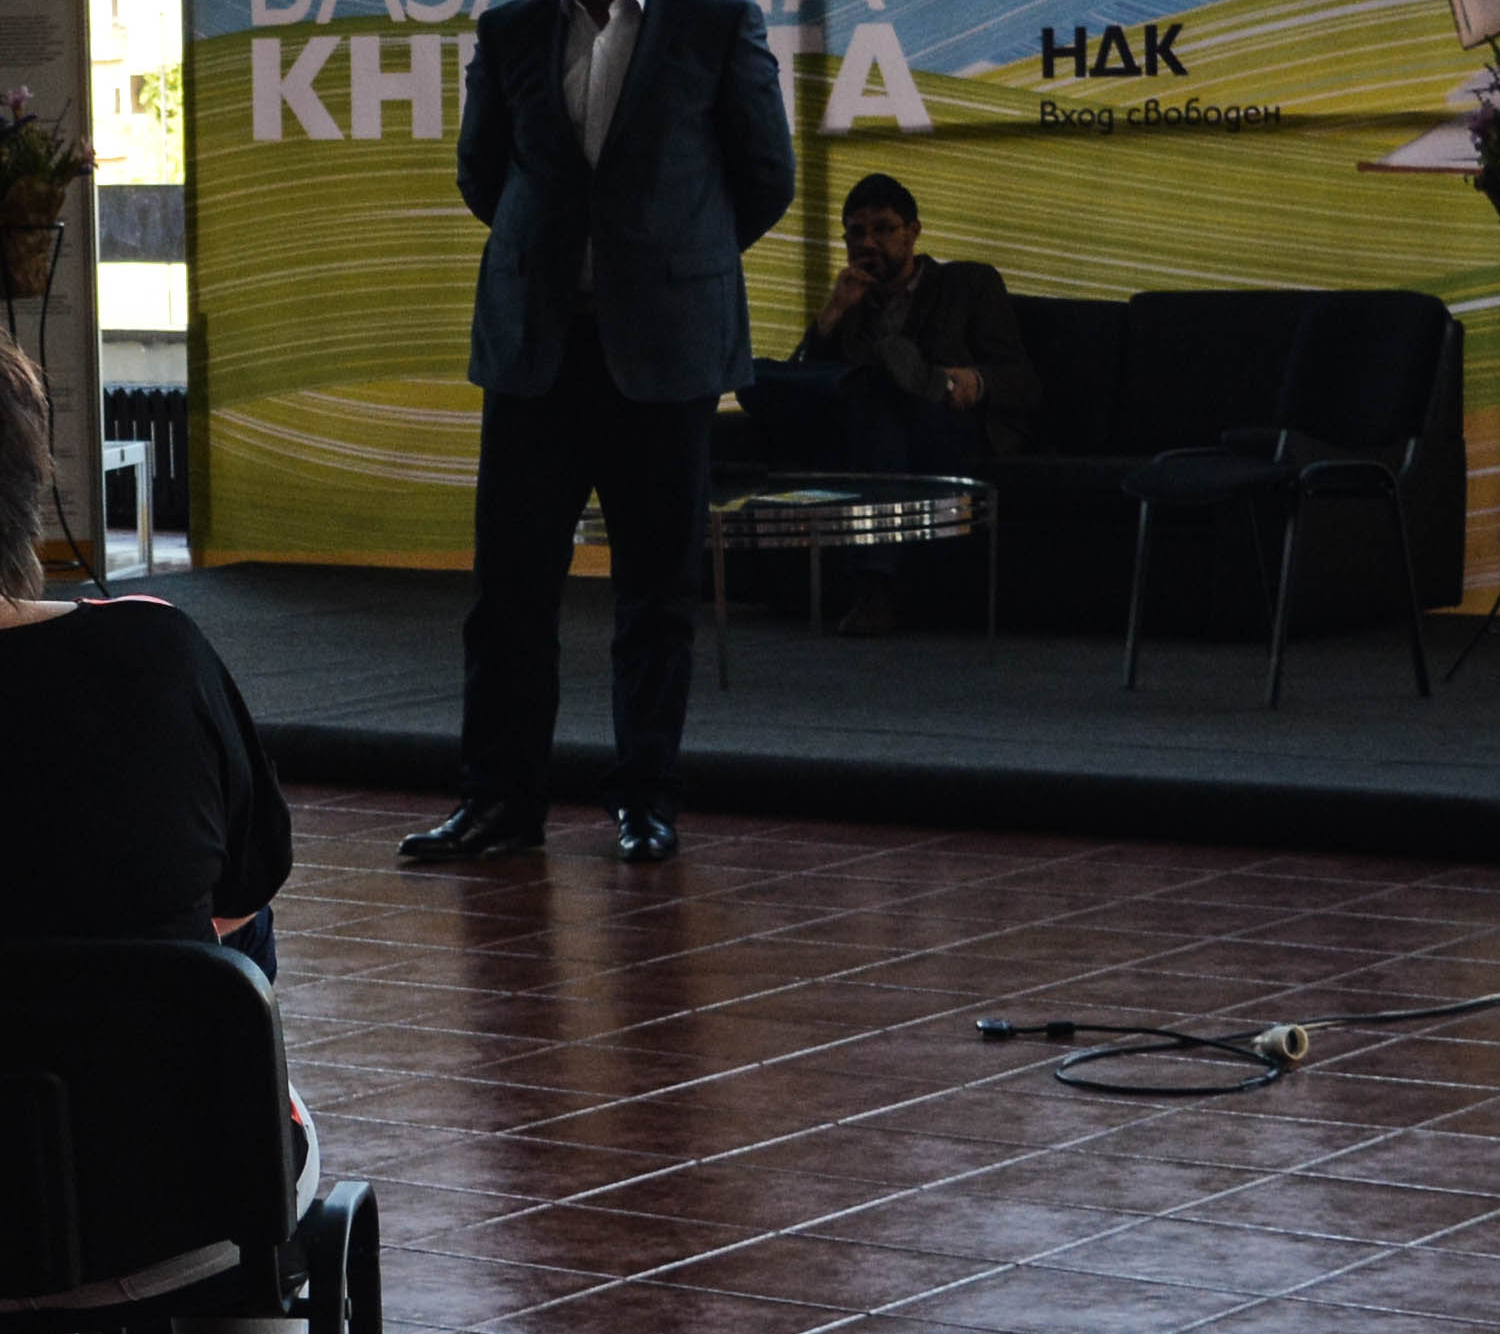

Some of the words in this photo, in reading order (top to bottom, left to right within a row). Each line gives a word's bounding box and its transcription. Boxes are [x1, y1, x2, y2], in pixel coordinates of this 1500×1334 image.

[1040, 23, 1189, 80] НДК
[1039, 99, 1117, 135] Вход
[1126, 96, 1283, 133] свободен
